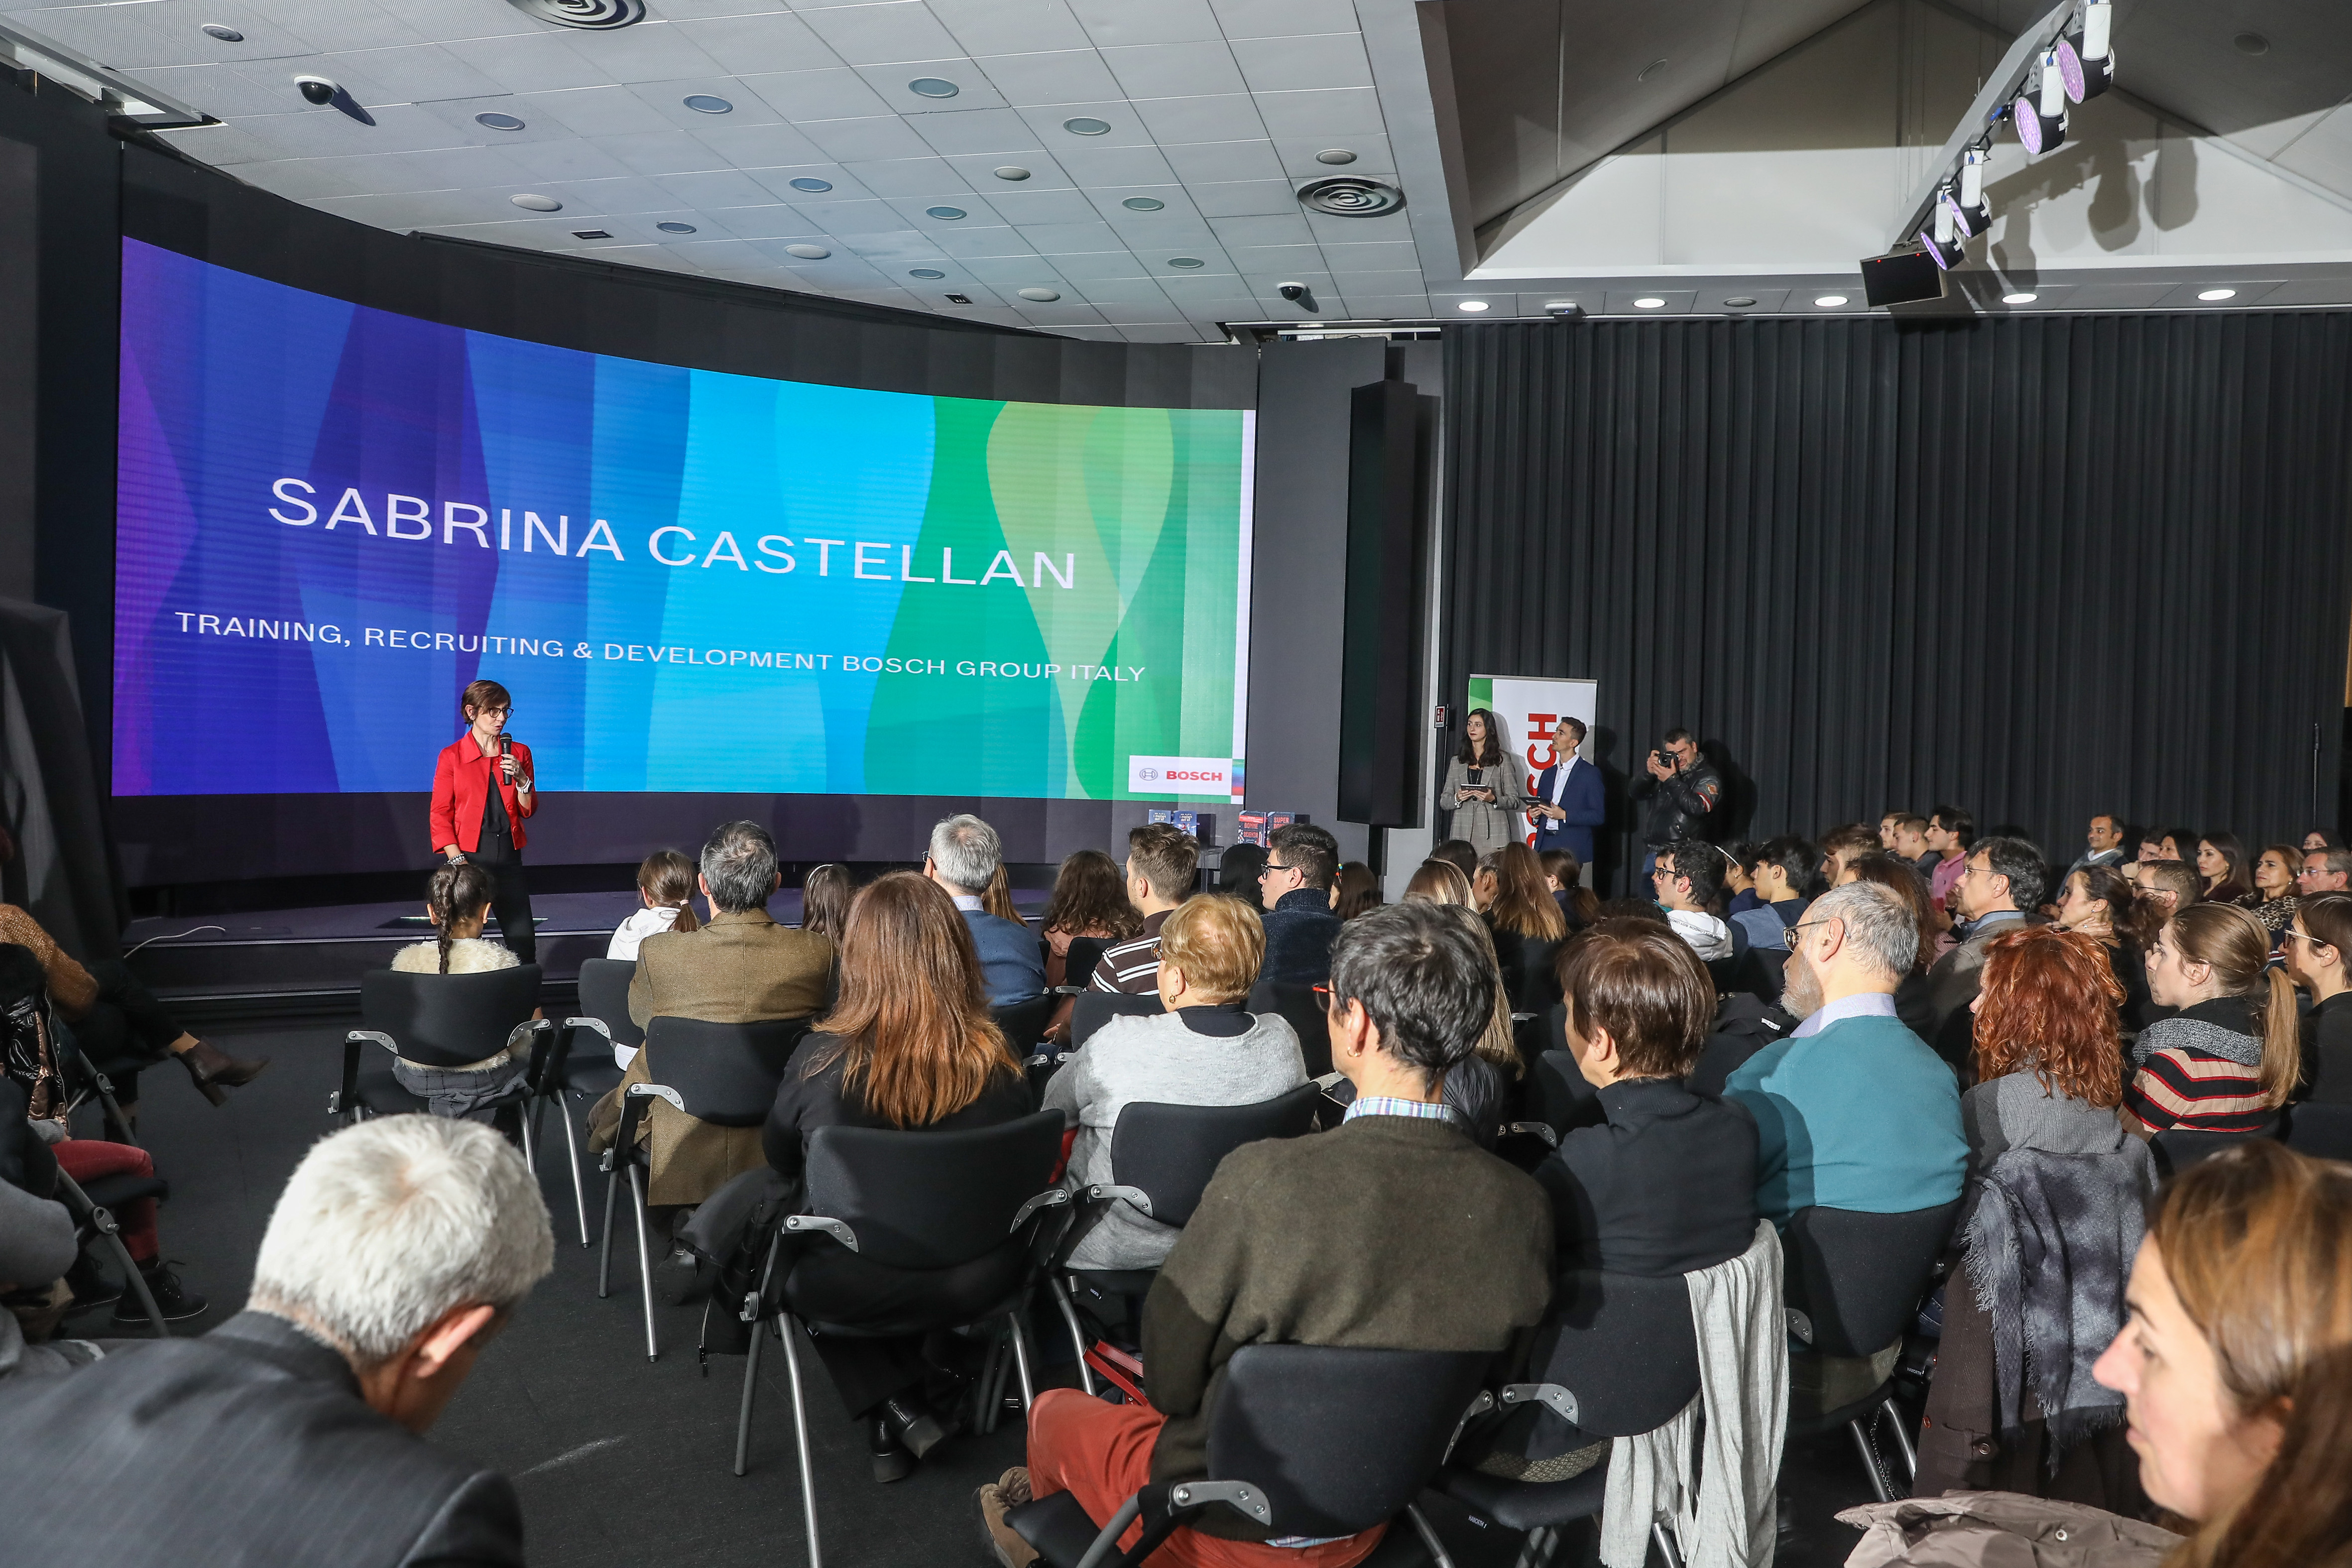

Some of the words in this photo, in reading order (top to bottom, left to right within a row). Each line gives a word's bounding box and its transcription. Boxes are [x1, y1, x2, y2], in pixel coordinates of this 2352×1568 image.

[268, 478, 624, 561] SABRINA
[648, 526, 1075, 589] CASTELLAN
[175, 611, 351, 648] TRAINING,
[364, 627, 563, 657] RECRUITING
[574, 641, 592, 659] &
[604, 643, 833, 670] DEVELOPMENT
[843, 655, 945, 675] BOSCH
[956, 660, 1061, 679] GROUP
[1070, 664, 1146, 682] ITALY
[1167, 771, 1222, 781] BOSCH
[1907, 1367, 1922, 1375] HAWORTH
[1468, 1515, 1484, 1527] HAWORTH
